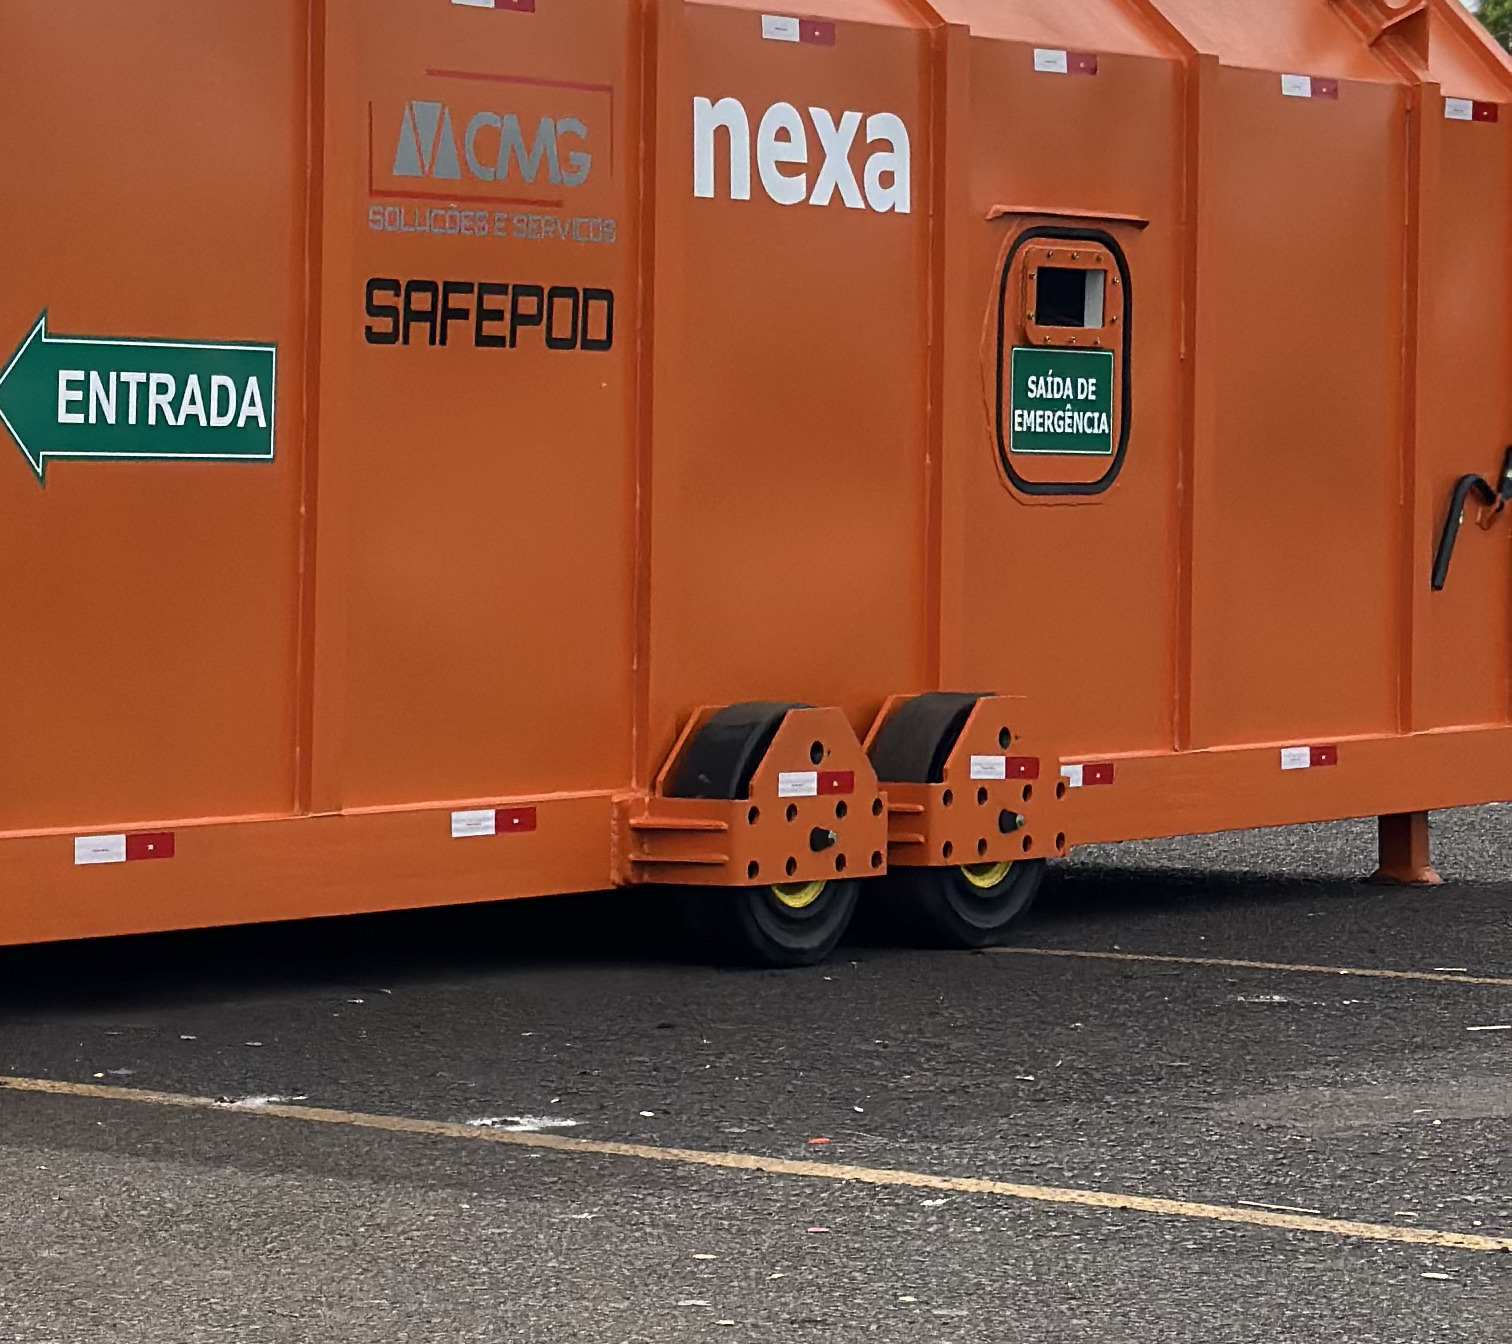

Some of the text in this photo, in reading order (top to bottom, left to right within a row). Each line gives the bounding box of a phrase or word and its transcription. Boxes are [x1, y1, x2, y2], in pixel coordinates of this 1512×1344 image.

[464, 111, 592, 187] CMG
[693, 95, 912, 214] nexa
[368, 203, 617, 246] SOLUÇÕES E SERVIÇOS
[364, 277, 615, 351] SAFEPOD
[57, 369, 267, 428] ENTRADA
[1027, 368, 1097, 400] SAÍDA DE
[1014, 403, 1109, 434] EMERGÊNCIA
